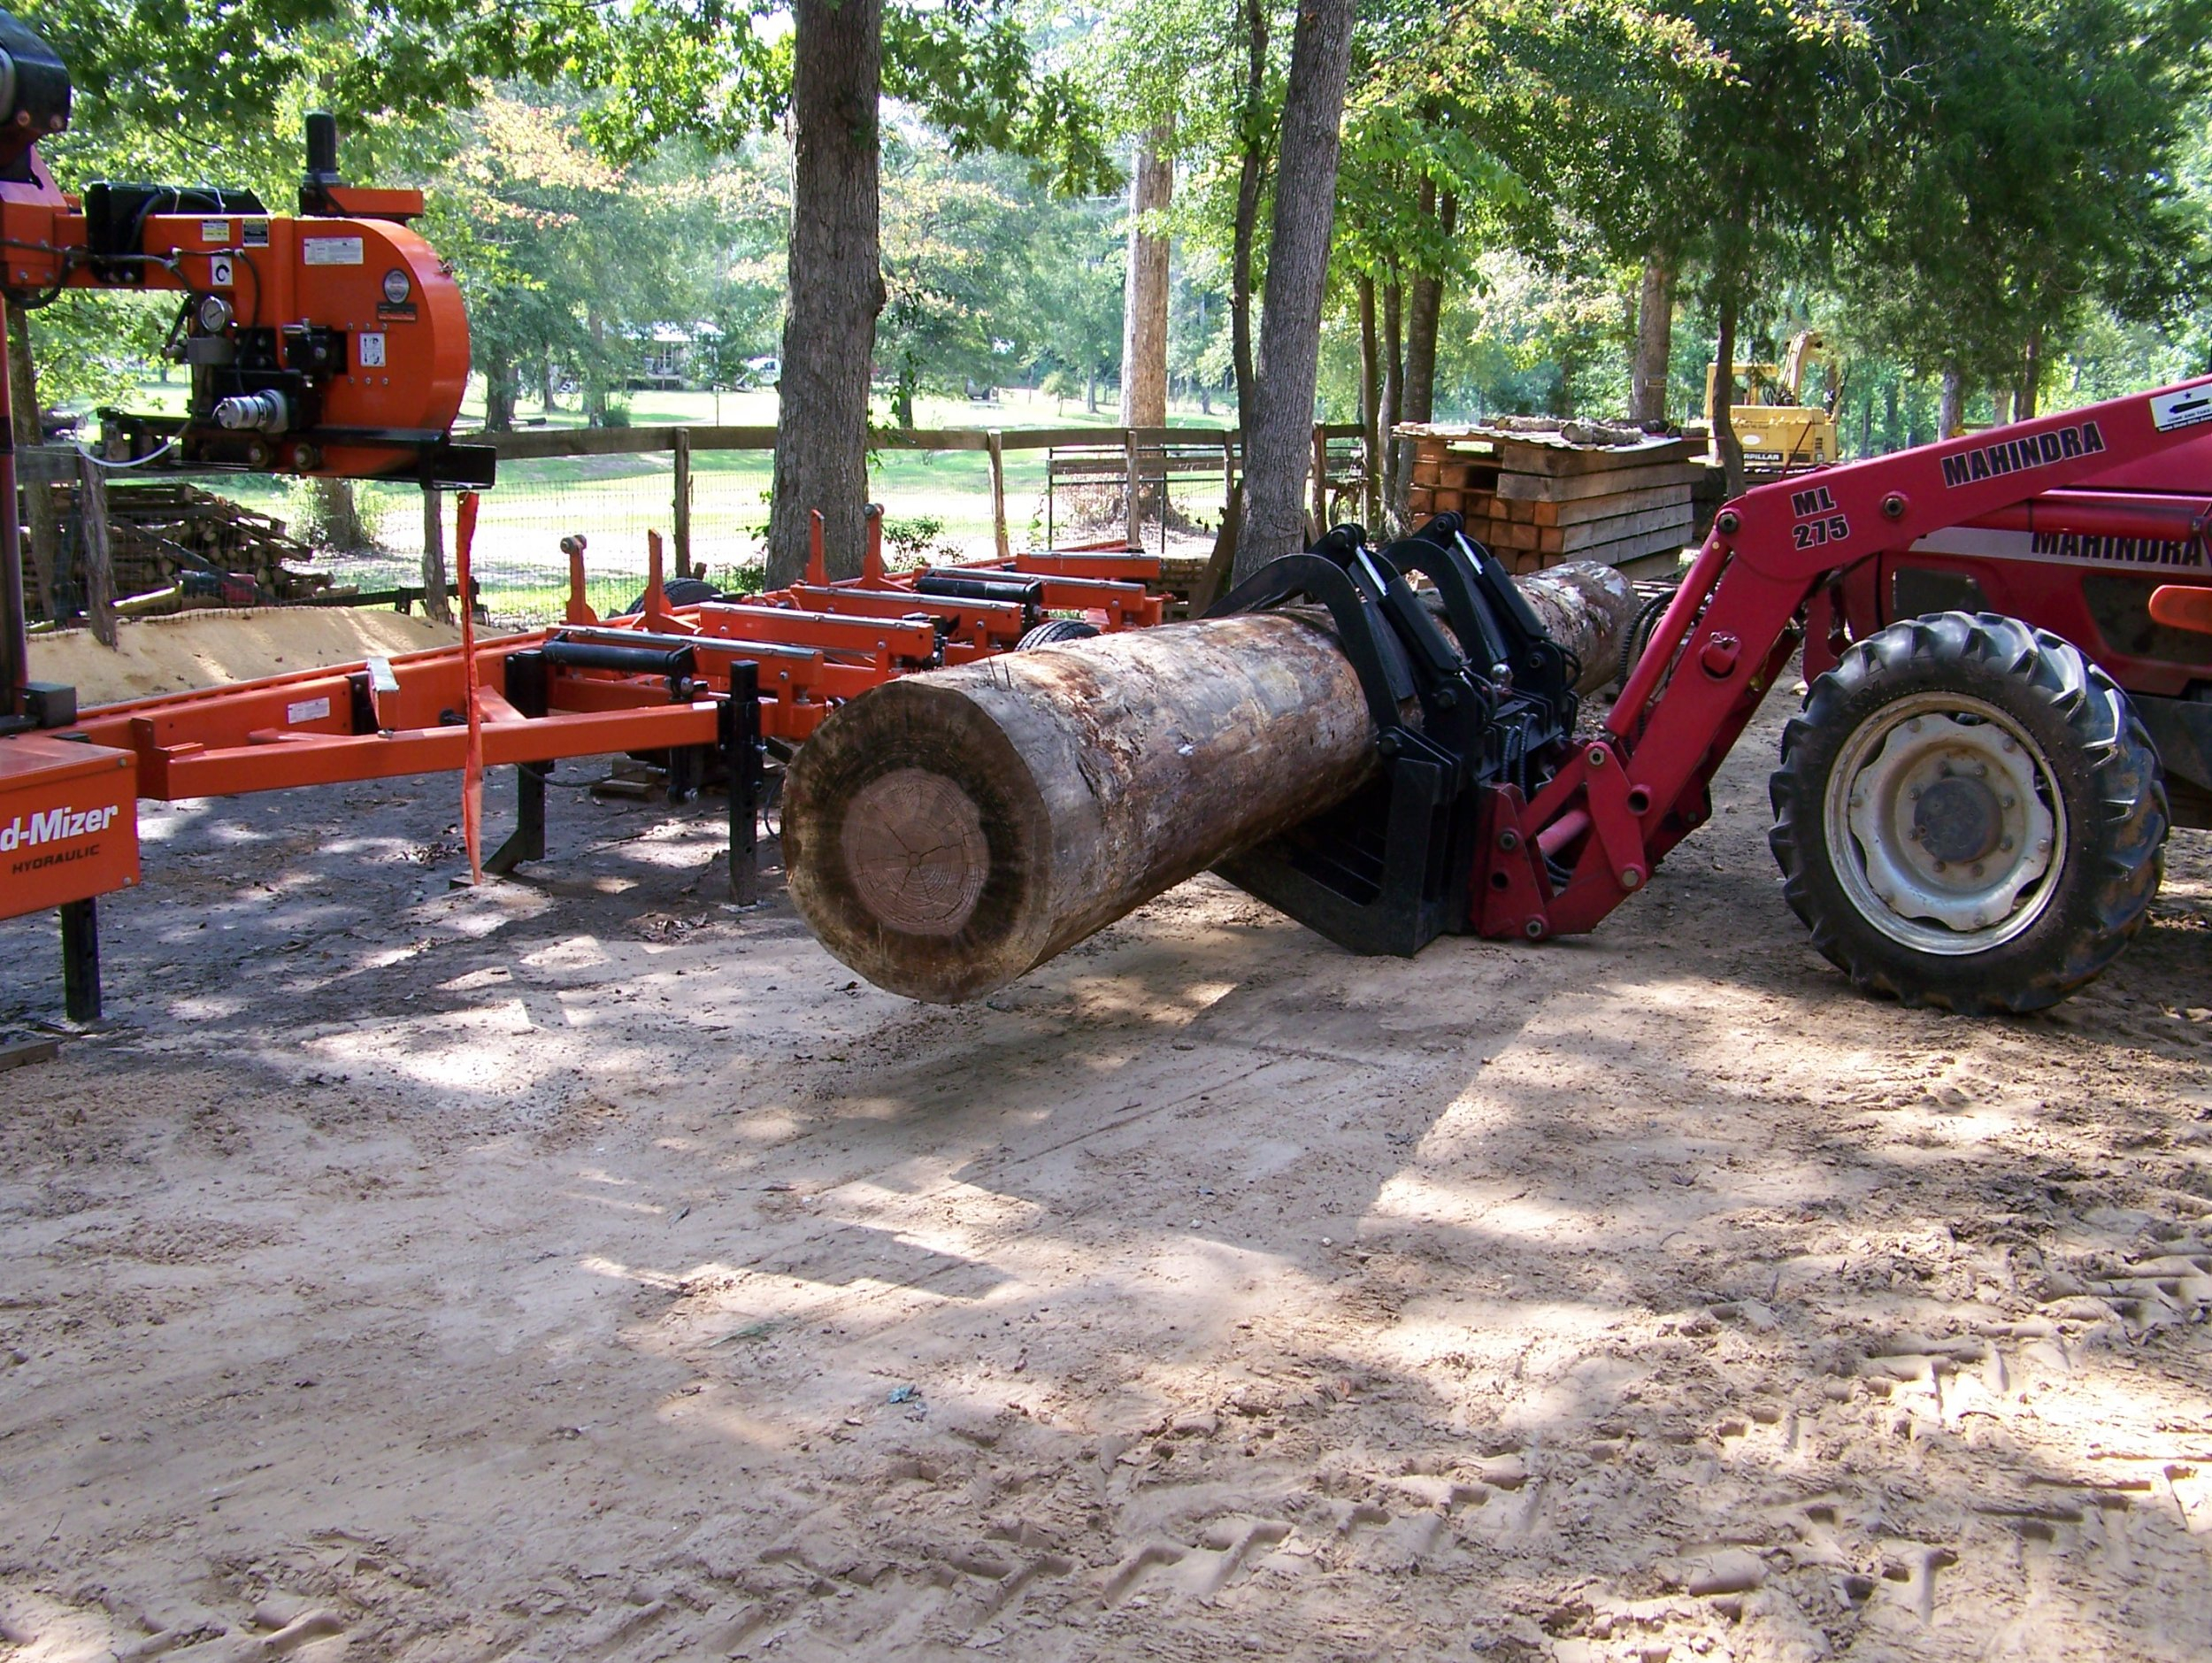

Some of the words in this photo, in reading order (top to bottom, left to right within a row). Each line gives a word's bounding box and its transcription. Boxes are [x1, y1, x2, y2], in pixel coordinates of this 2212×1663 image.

[1940, 420, 2106, 489] MAHINDRA
[1791, 486, 1837, 519] ML
[1792, 514, 1849, 550] 275
[2032, 532, 2203, 567] MAHINDRA
[0, 805, 119, 852] d-Mizer
[12, 844, 100, 874] HYDRAULIC
